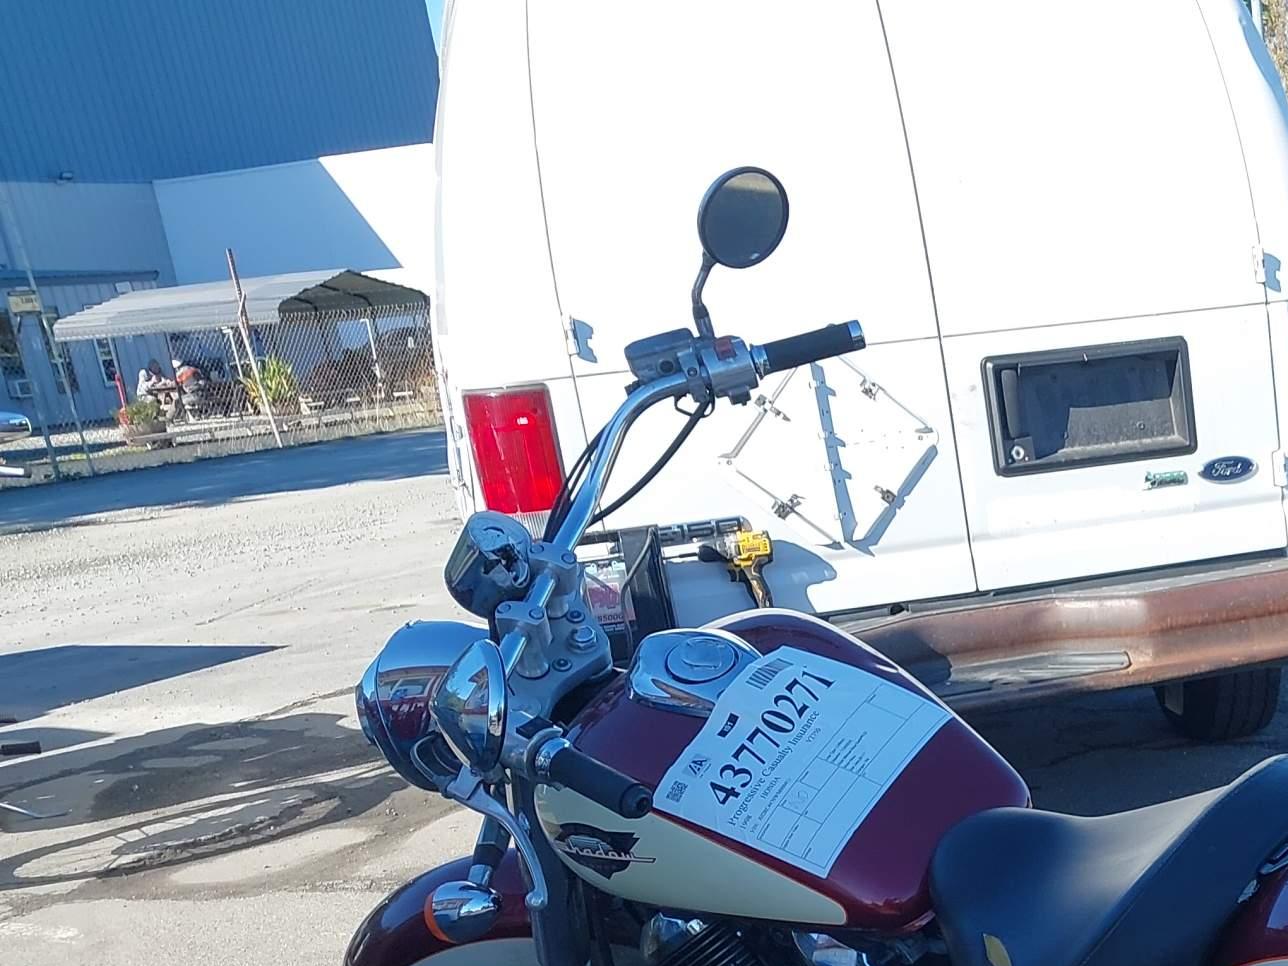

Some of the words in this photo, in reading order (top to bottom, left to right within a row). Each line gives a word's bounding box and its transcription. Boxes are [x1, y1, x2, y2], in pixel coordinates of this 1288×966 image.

[709, 669, 836, 806] 43770271
[728, 775, 766, 827] Progressive
[762, 745, 793, 777] Casualty
[789, 710, 820, 746] Insurance
[760, 777, 782, 800] HONDA
